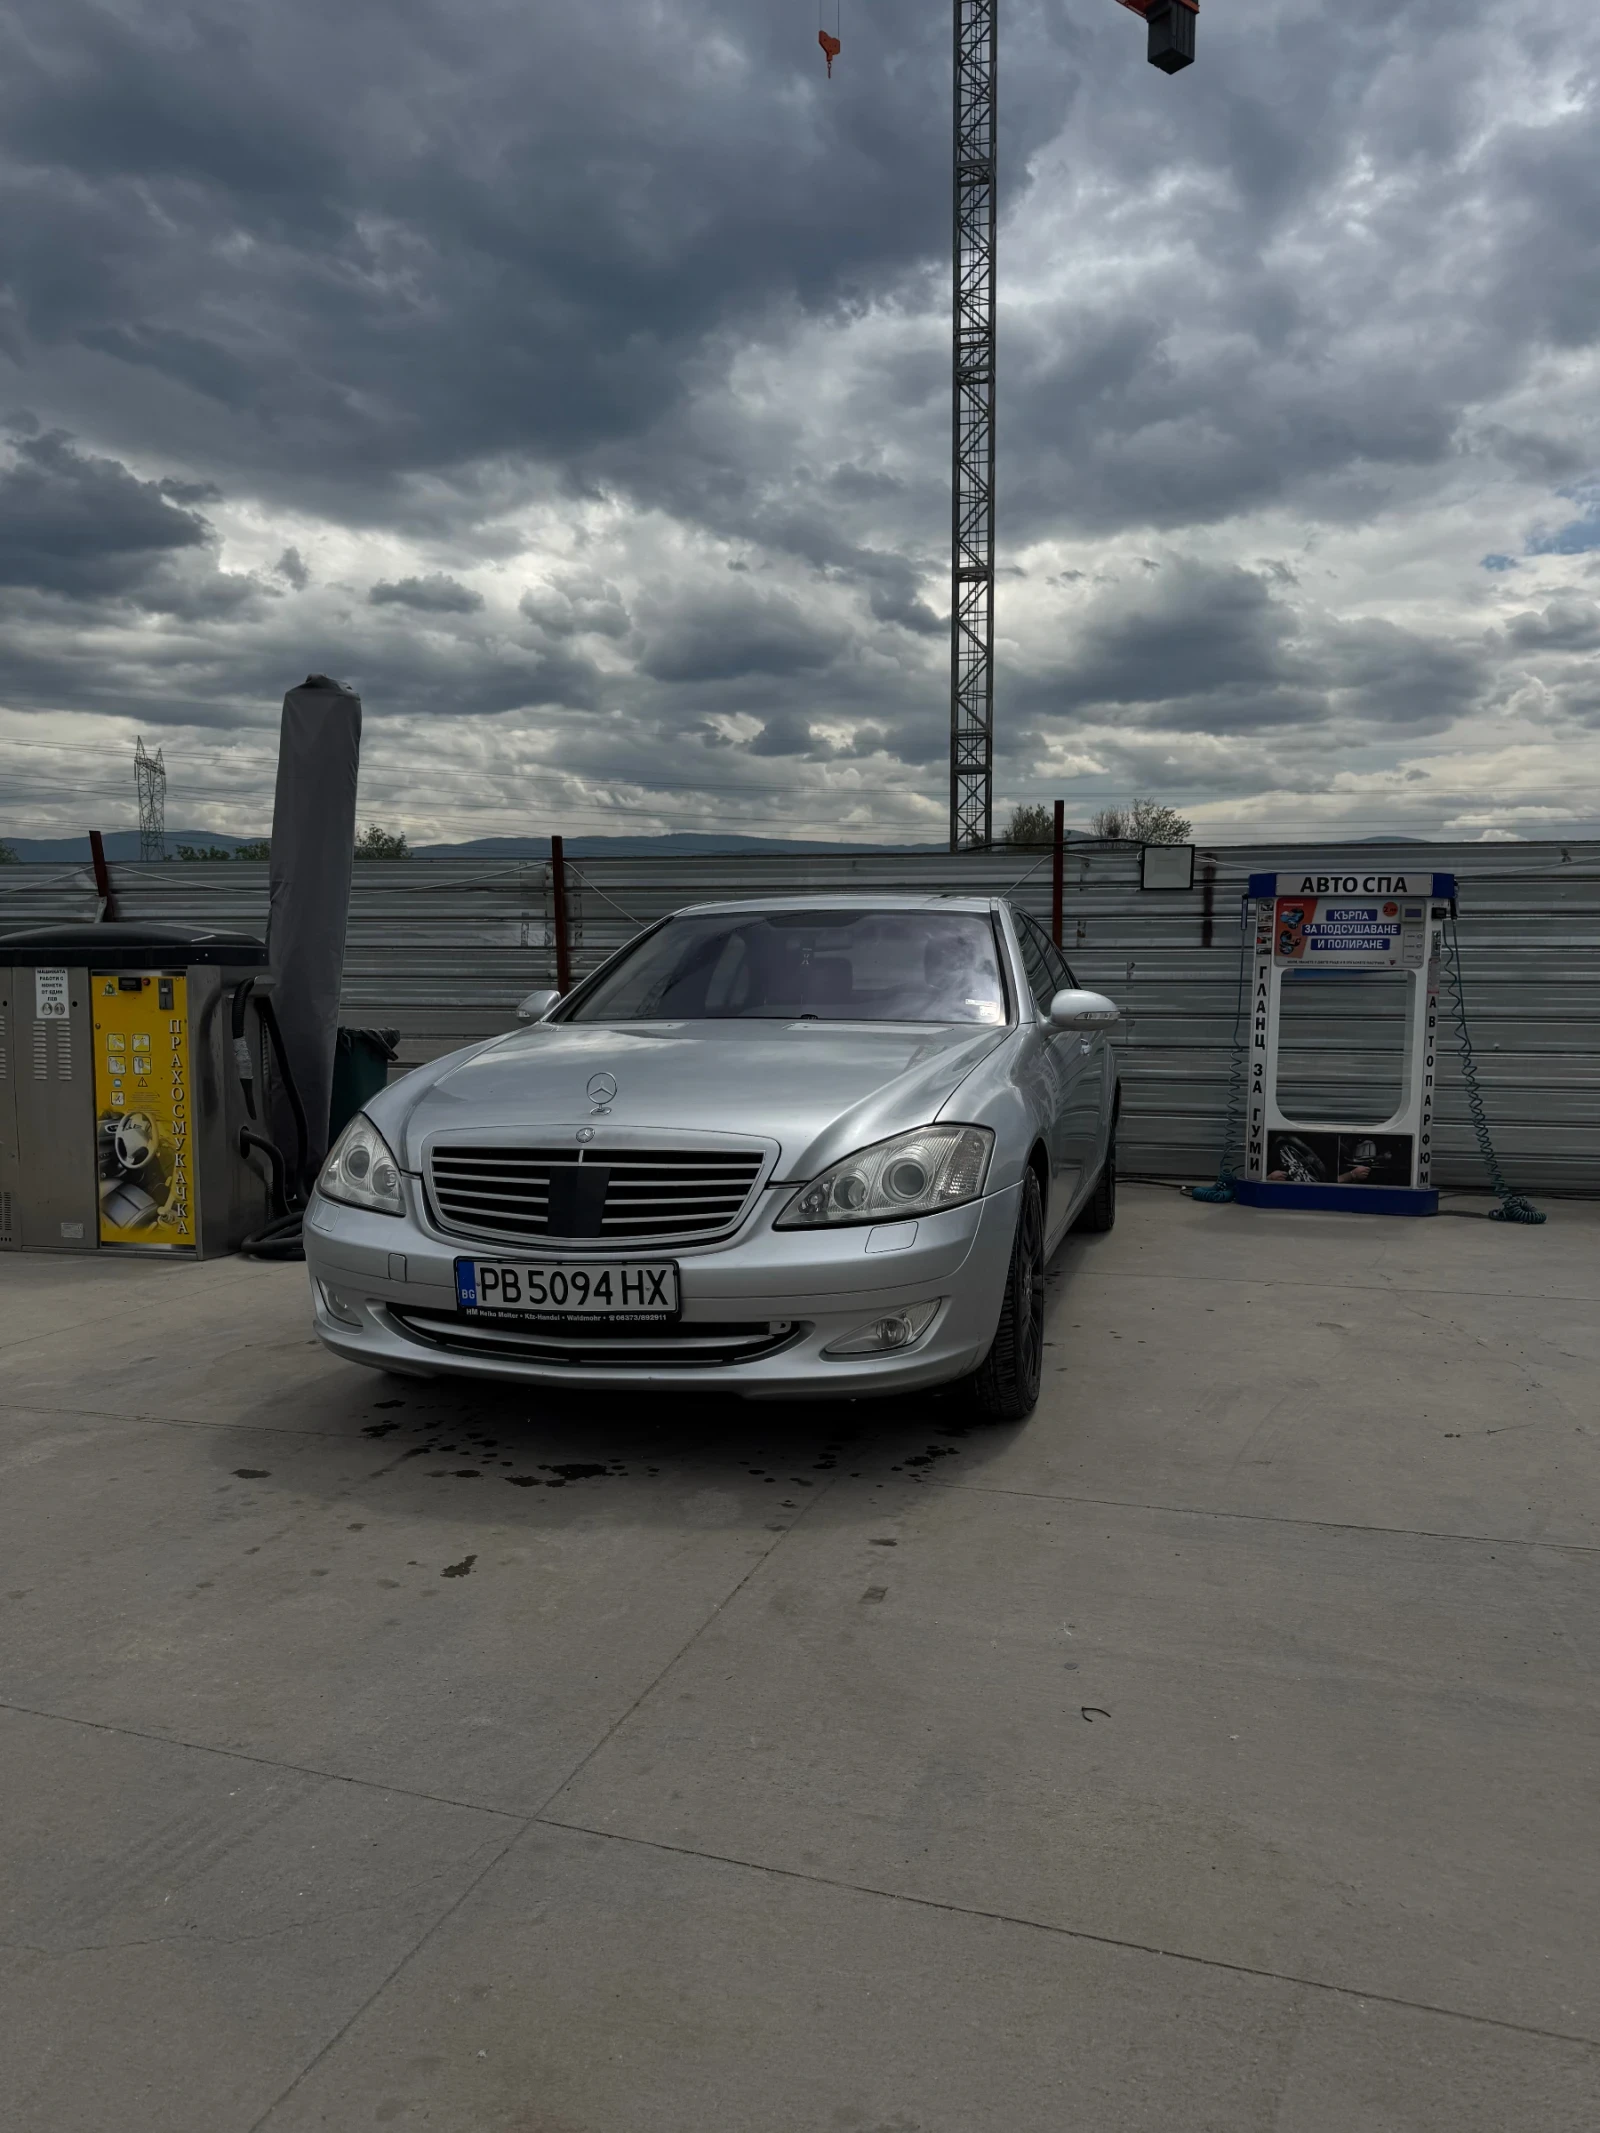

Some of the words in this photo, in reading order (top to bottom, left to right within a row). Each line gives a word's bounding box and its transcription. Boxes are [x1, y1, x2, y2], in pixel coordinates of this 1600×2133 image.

[1300, 876, 1358, 893] АВТО
[1362, 876, 1408, 893] СПА
[1333, 910, 1370, 920] КЪРПА
[1304, 924, 1317, 934] ЗА
[1320, 924, 1398, 935] ПОДСУШАВАНЕ
[1317, 939, 1325, 949] И
[1327, 939, 1383, 949] ПОЛИРАНЕ
[1254, 965, 1268, 1050] ГЛАНЦ
[1252, 1063, 1263, 1094] ЗА
[1419, 995, 1437, 1184] АВТОПАРФЮМ
[169, 1019, 189, 1235] ПРАХОСМУКАЧКА
[1250, 1107, 1261, 1172] ГУМИ
[461, 1289, 475, 1299] BG
[480, 1267, 522, 1303] PB
[527, 1270, 613, 1306] 5094
[621, 1269, 669, 1306] HX
[466, 1308, 479, 1316] HM
[567, 1314, 601, 1322] Waldmohr
